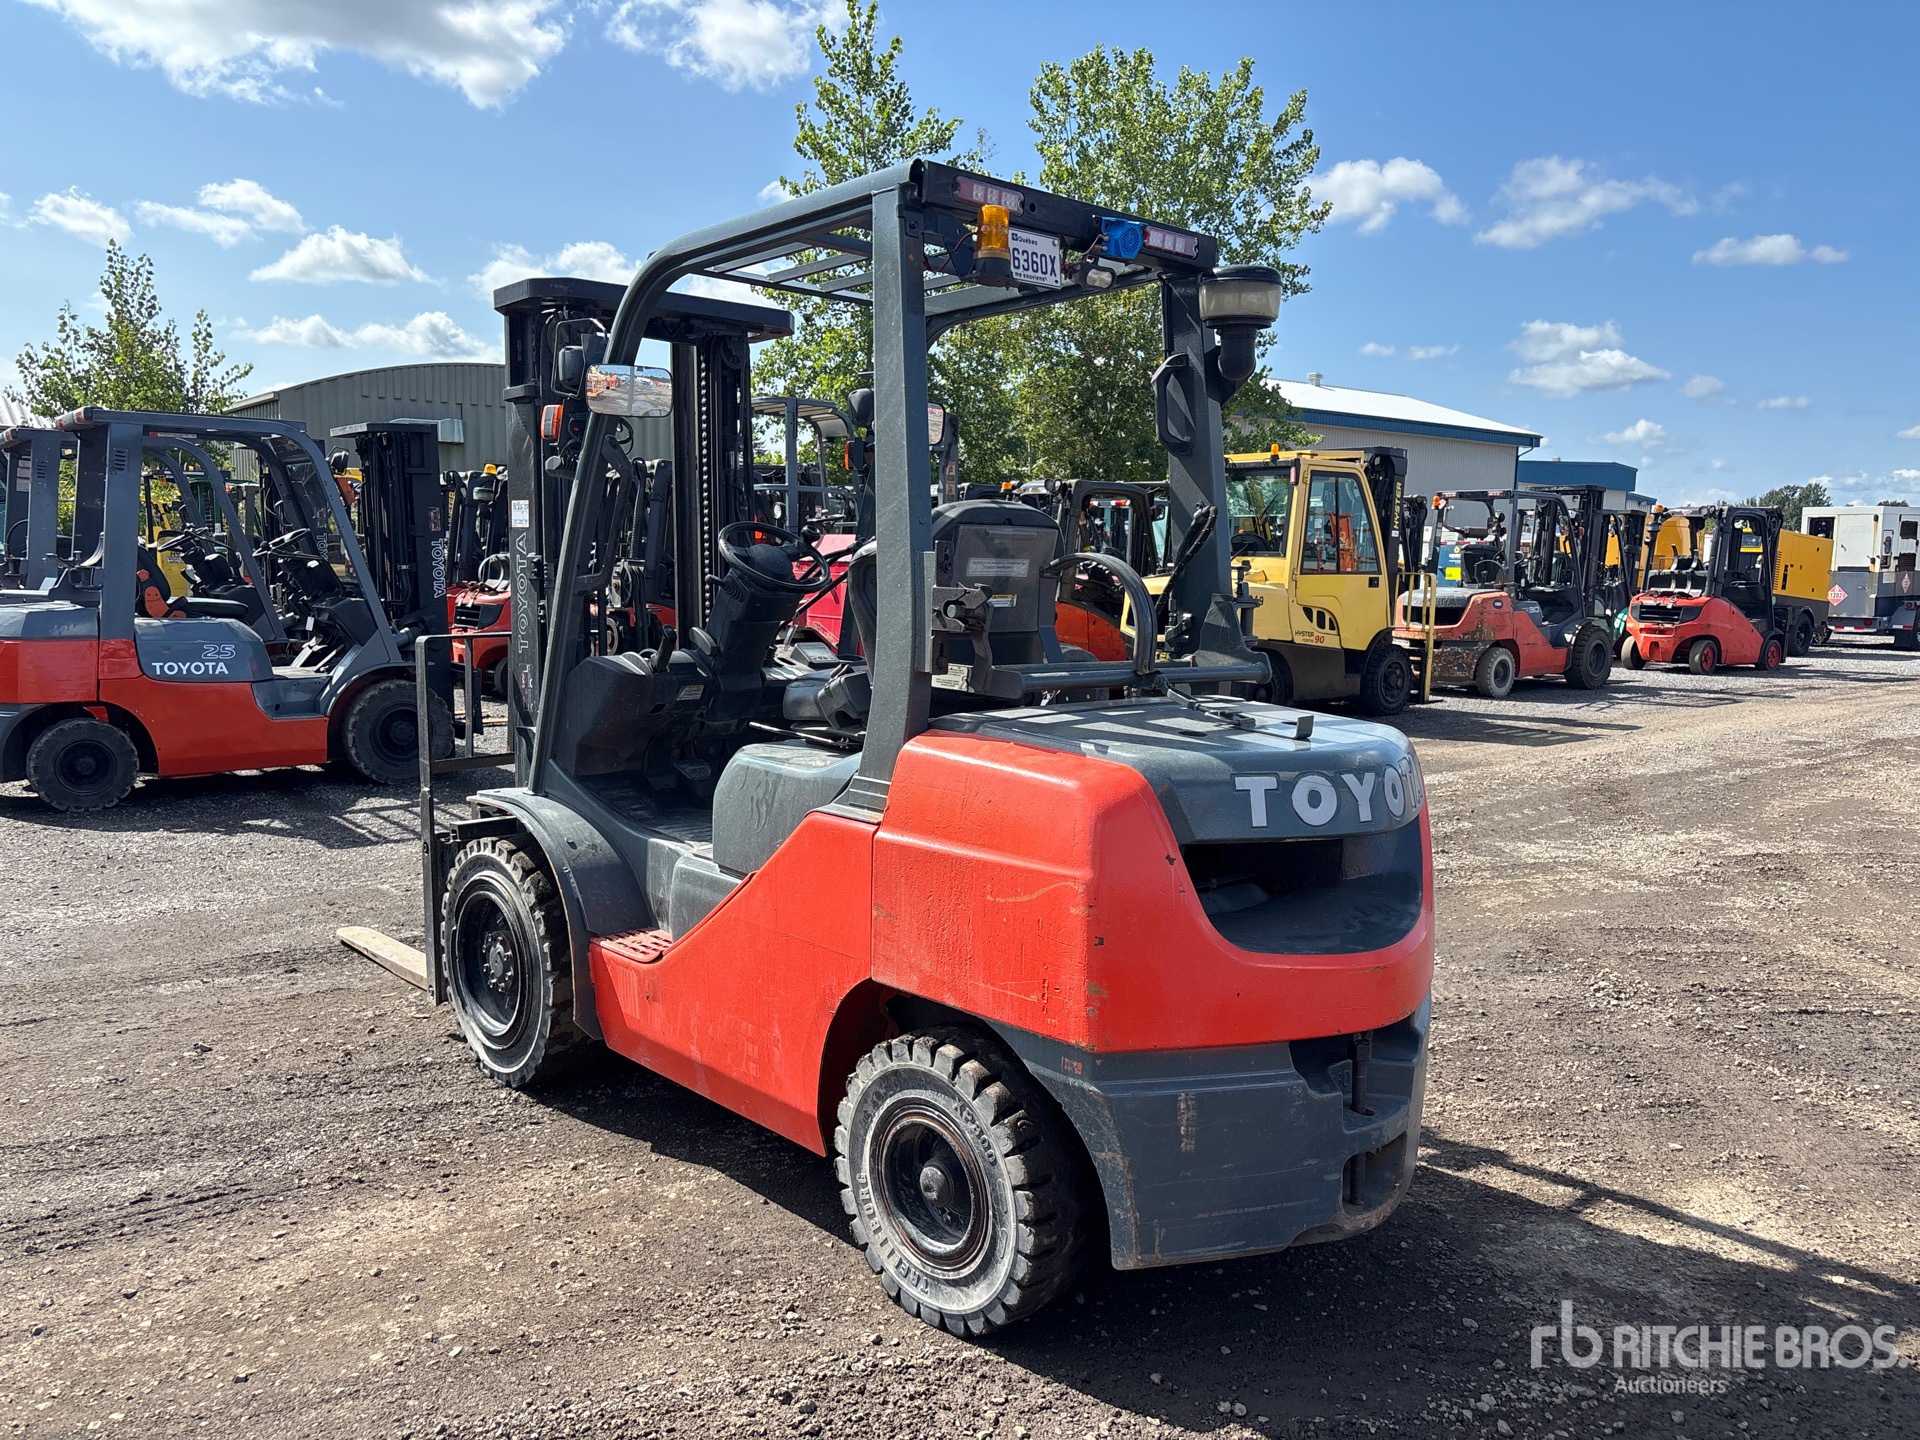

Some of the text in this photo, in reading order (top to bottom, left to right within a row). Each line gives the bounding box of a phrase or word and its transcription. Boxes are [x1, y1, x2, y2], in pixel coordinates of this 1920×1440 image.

[1012, 247, 1057, 278] 6360X
[1393, 481, 1402, 530] HYSTER
[431, 538, 447, 599] TOYOTA
[516, 531, 530, 654] TOYOTA
[201, 644, 236, 659] 25
[1314, 635, 1325, 644] 90
[151, 661, 229, 675] TOYOTA
[1234, 753, 1425, 828] TOYOTA
